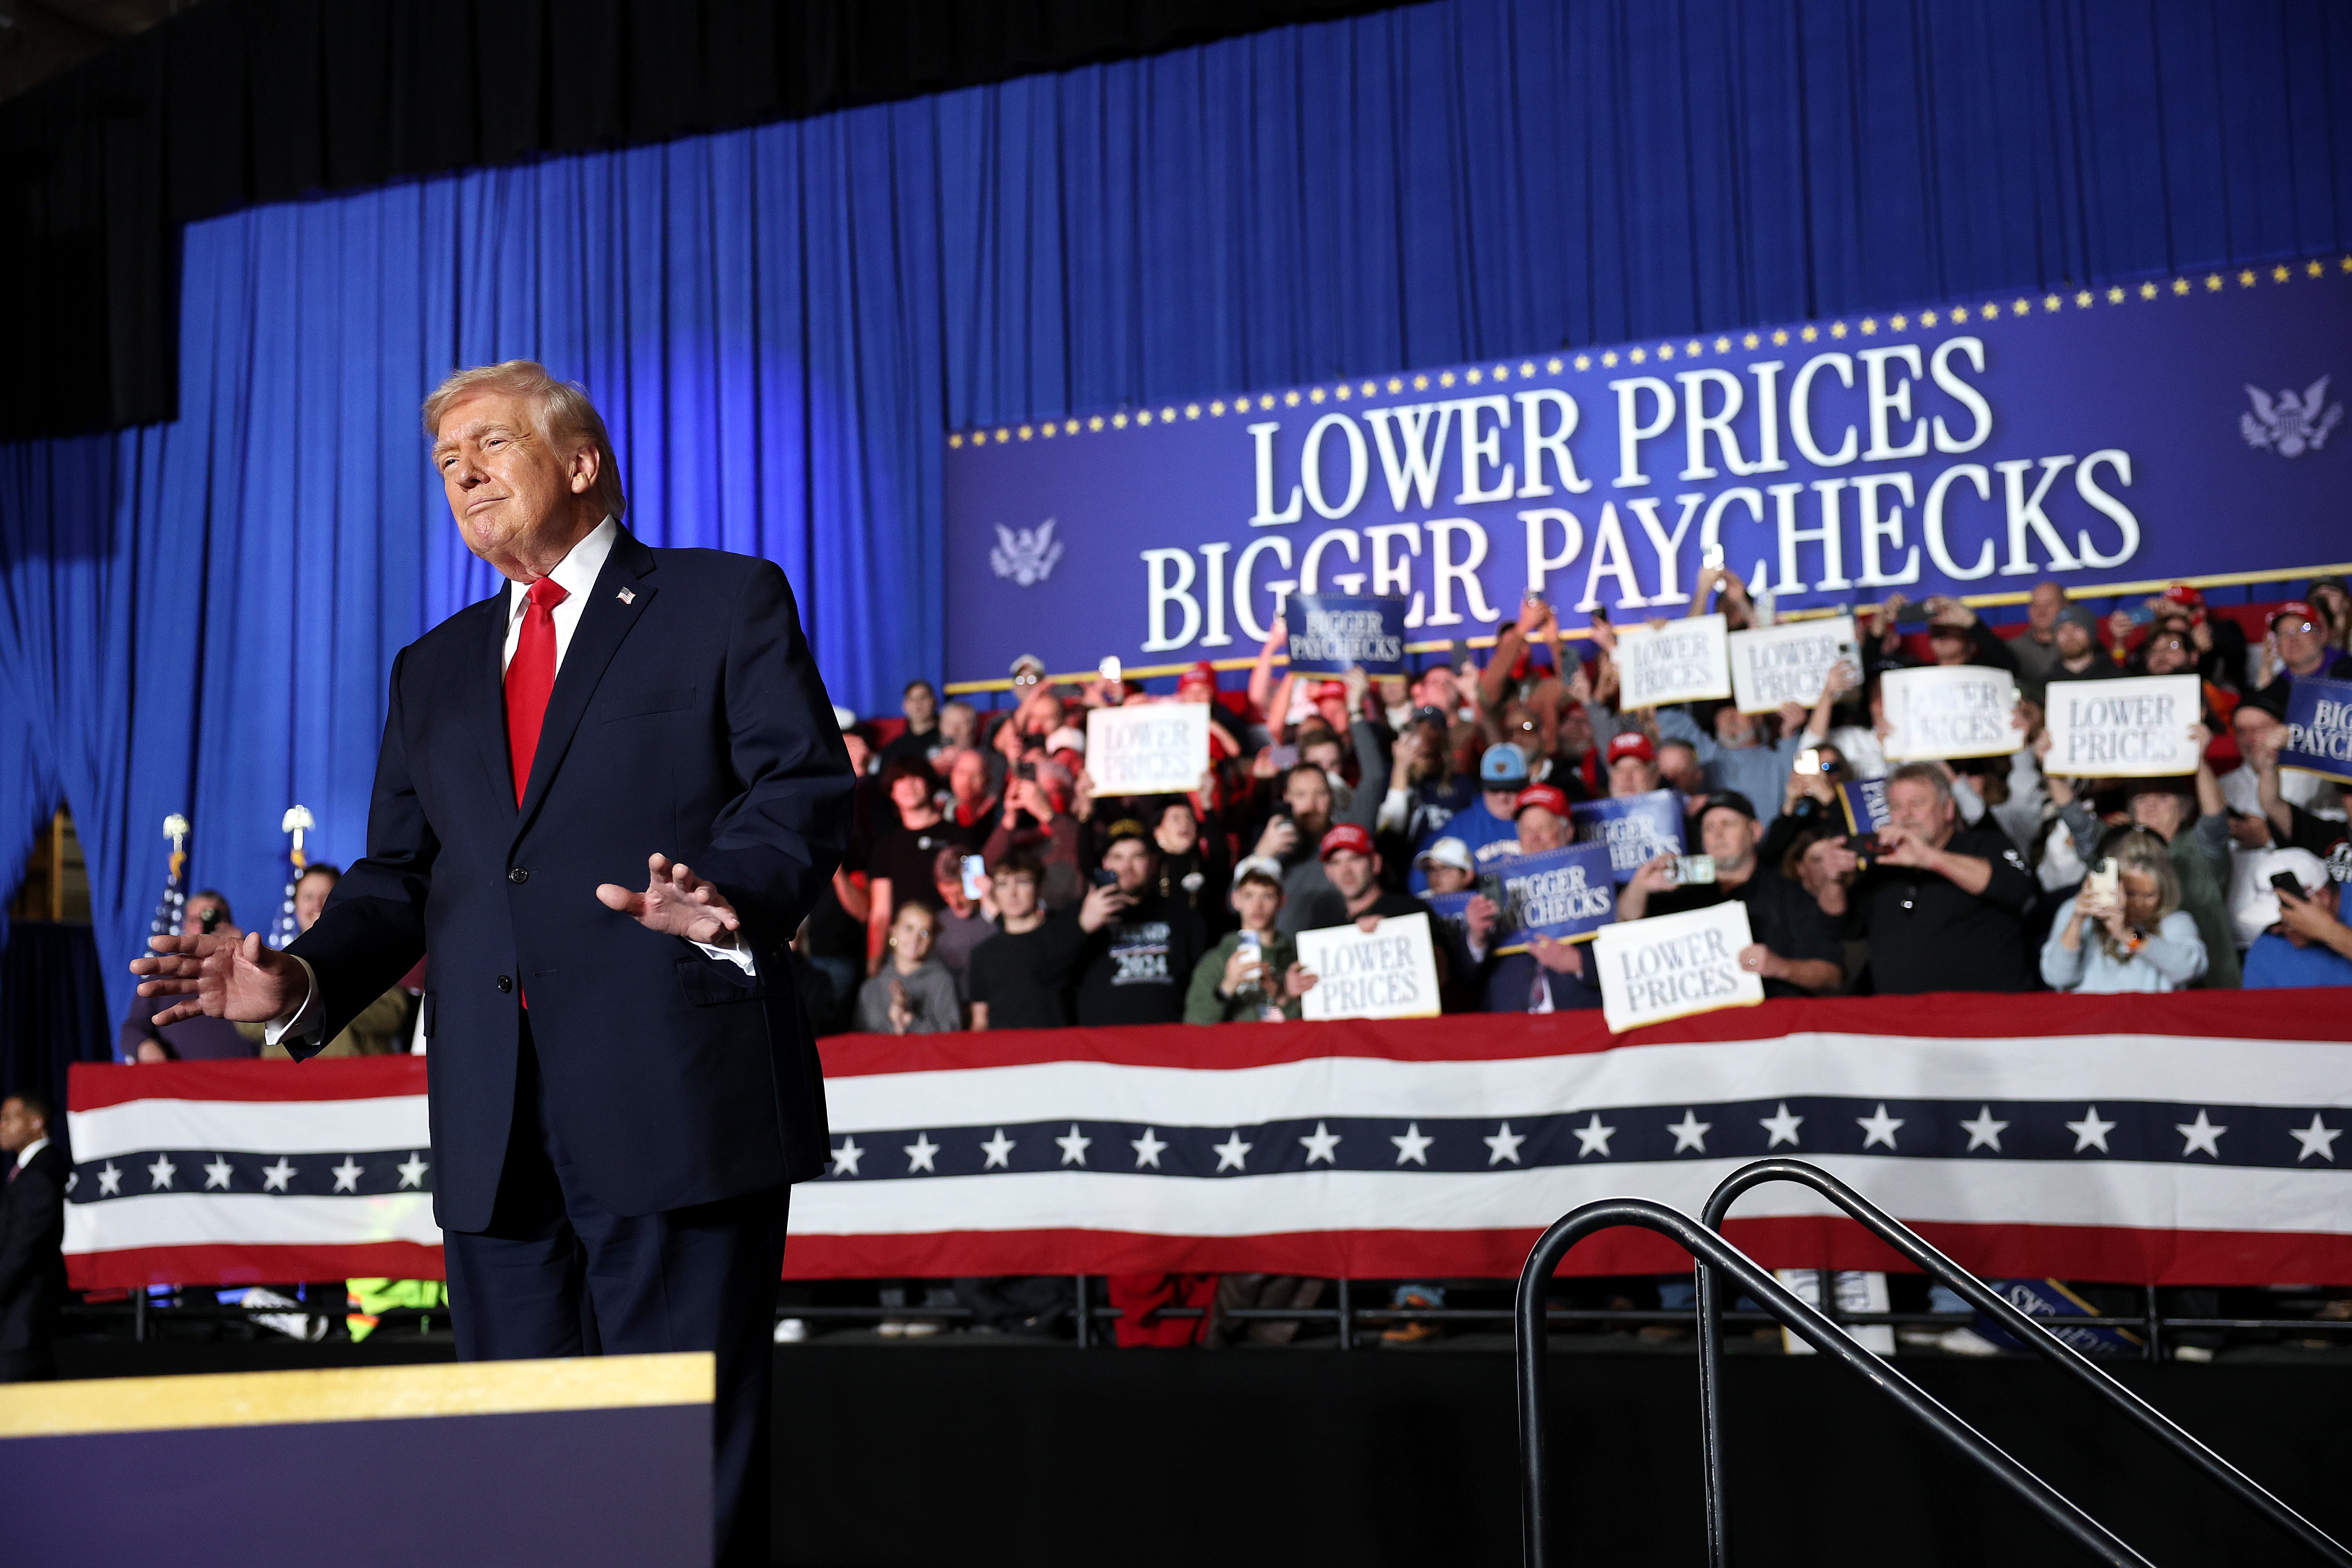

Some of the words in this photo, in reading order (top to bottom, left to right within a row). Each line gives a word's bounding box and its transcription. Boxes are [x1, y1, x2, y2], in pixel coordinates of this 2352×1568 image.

[1246, 388, 1592, 528] LOWER
[1608, 336, 1993, 489] PRICES
[1139, 517, 1501, 653] BIGGER
[1517, 448, 2140, 614] PAYCHECKS
[1306, 609, 1384, 636] BIGGER
[1290, 633, 1402, 663] PAYCHECKS
[1632, 631, 1710, 667] LOWER
[1749, 635, 1840, 669] LOWER
[1634, 662, 1714, 699] PRICES
[1750, 667, 1829, 703] PRICE
[1901, 681, 2000, 715] LER
[2069, 694, 2175, 728] LOWER
[2313, 699, 2352, 731] BIG
[2068, 727, 2177, 764] PRICES
[1319, 935, 1415, 978] LOWER
[1620, 927, 1729, 981] LOWER
[1322, 971, 1419, 1014] PRICES
[1627, 962, 1738, 1012] PRICES
